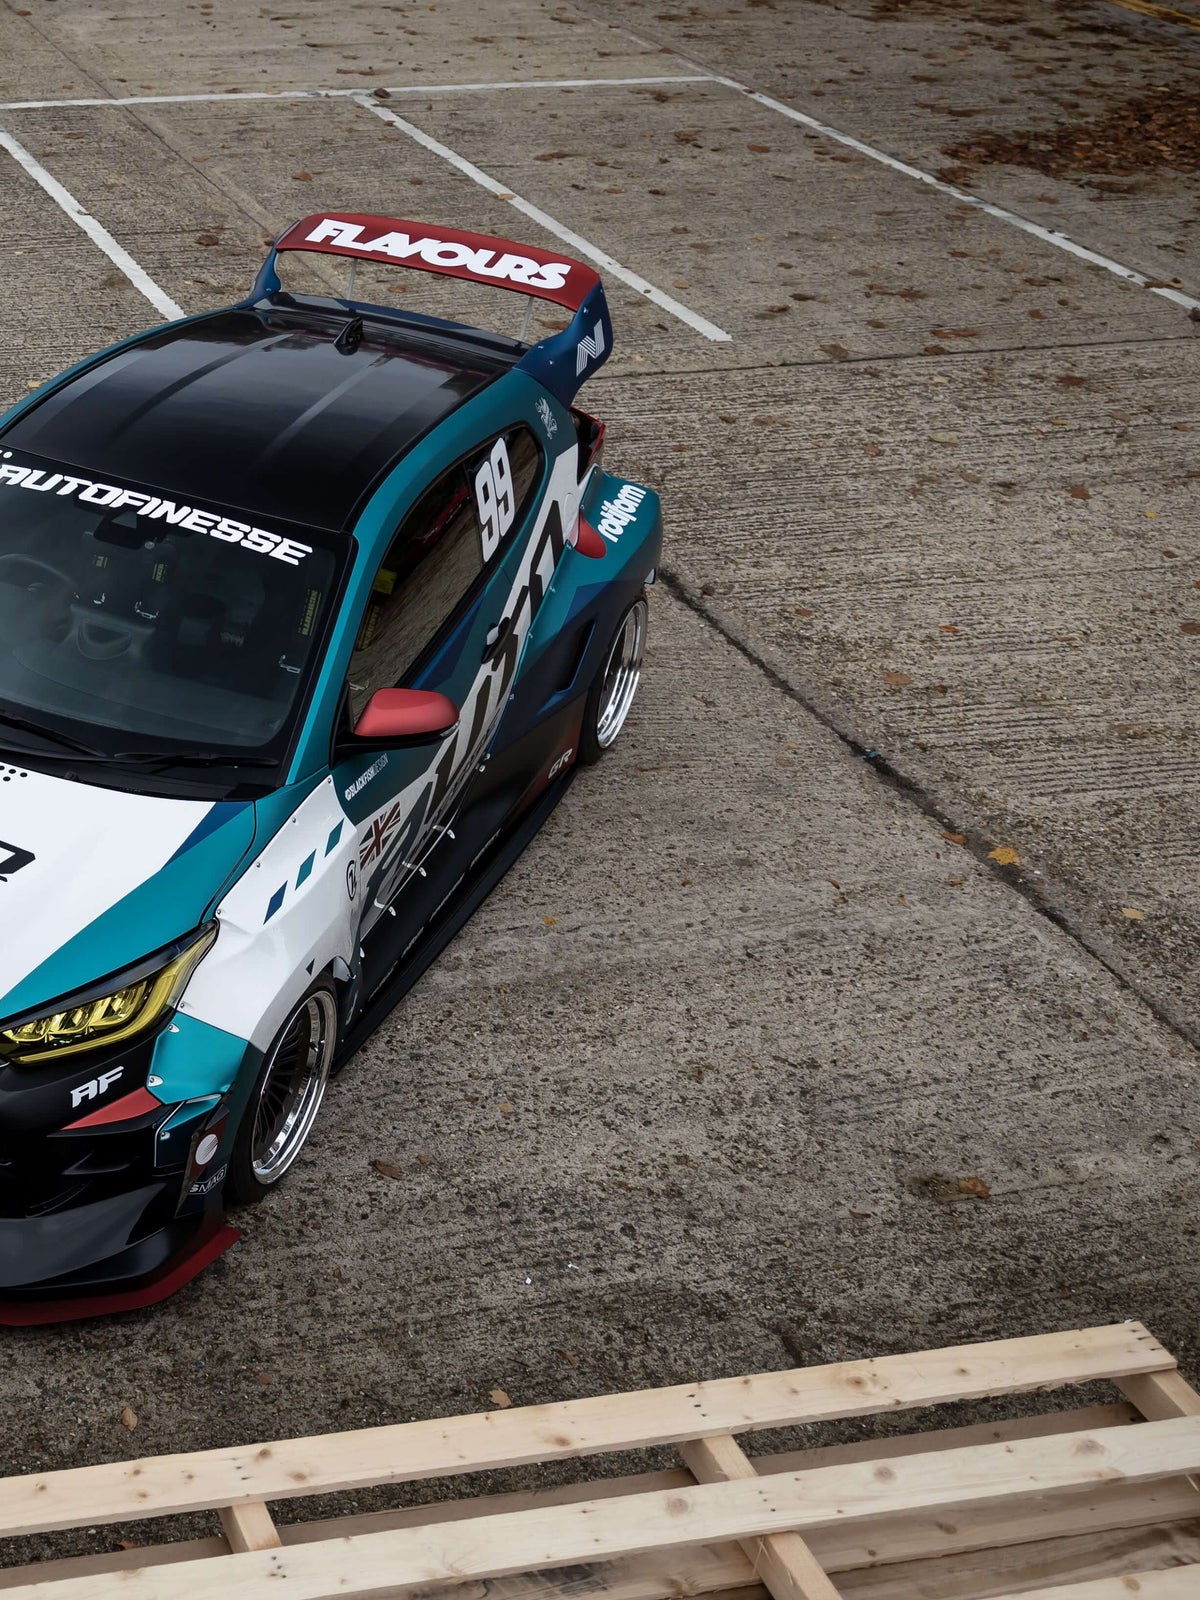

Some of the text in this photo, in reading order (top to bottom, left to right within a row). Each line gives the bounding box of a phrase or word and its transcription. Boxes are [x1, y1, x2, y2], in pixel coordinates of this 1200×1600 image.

[305, 218, 571, 289] FLAVOURS
[475, 438, 515, 562] 99
[598, 484, 646, 543] rotiform
[548, 748, 573, 780] GR
[70, 1066, 124, 1108] AF
